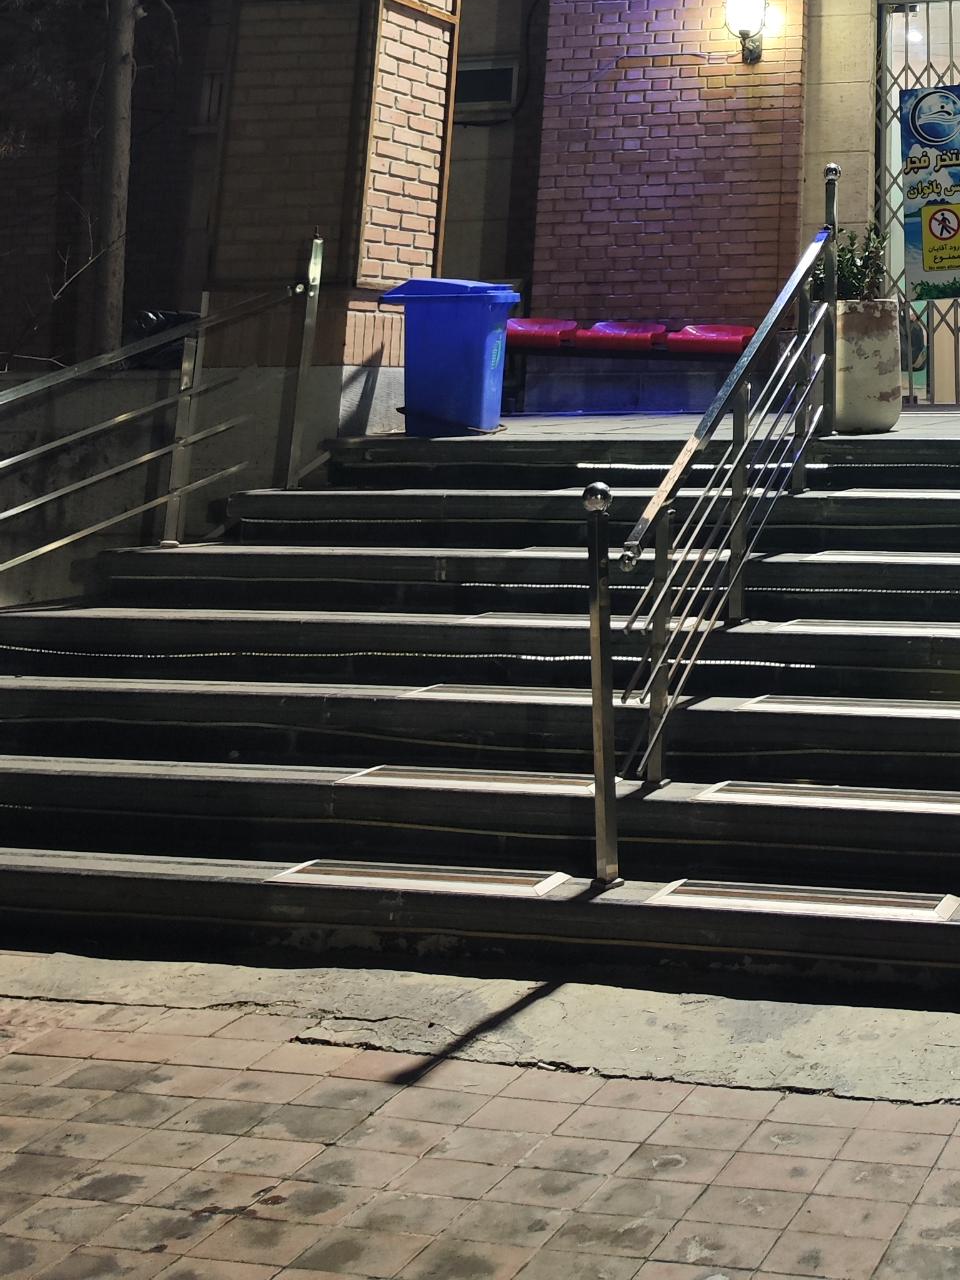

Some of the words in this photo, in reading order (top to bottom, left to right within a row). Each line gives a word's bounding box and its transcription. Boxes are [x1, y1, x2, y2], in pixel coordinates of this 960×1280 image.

[904, 151, 930, 175] فجر
[907, 179, 942, 199] بانوان
[934, 254, 960, 263] ممنوع
